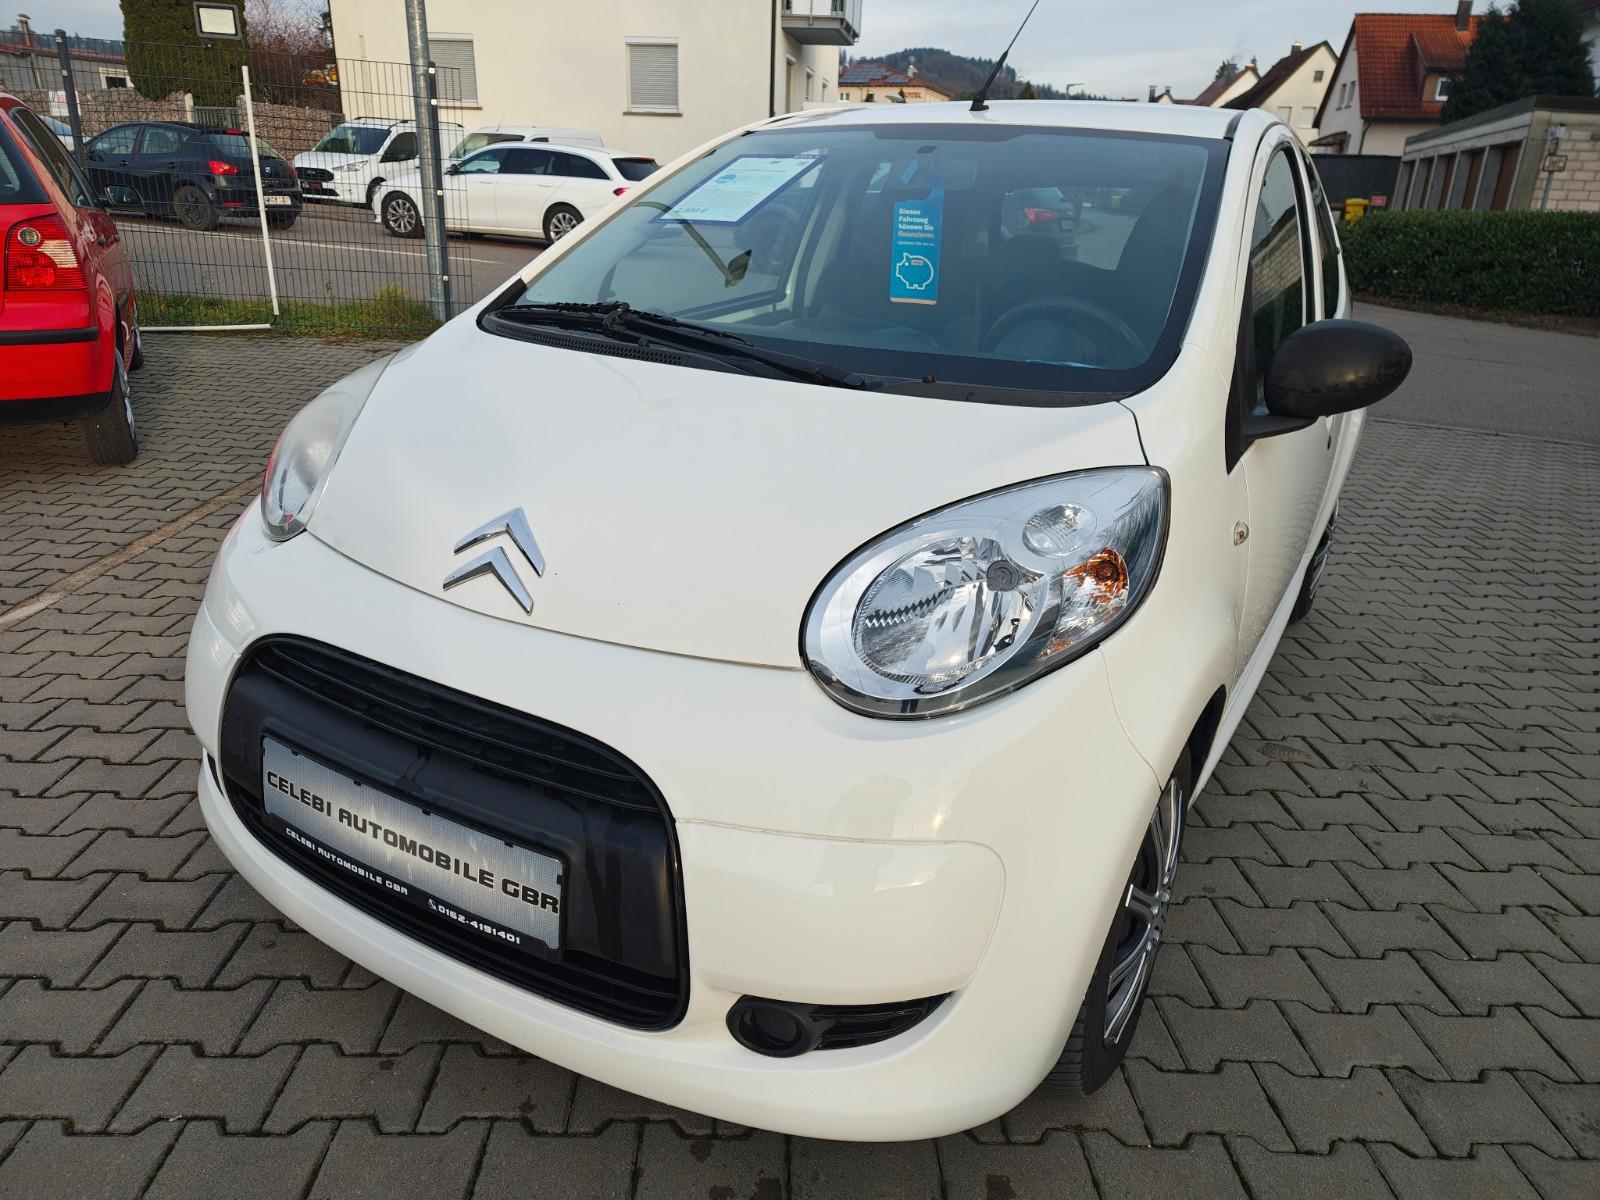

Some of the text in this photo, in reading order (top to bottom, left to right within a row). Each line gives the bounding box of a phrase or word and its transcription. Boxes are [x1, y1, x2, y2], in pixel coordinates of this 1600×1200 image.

[267, 770, 560, 914] CELEBI AUTOMOBILE GBR
[285, 827, 408, 896] CELEBI AUTOMOBILE GBR
